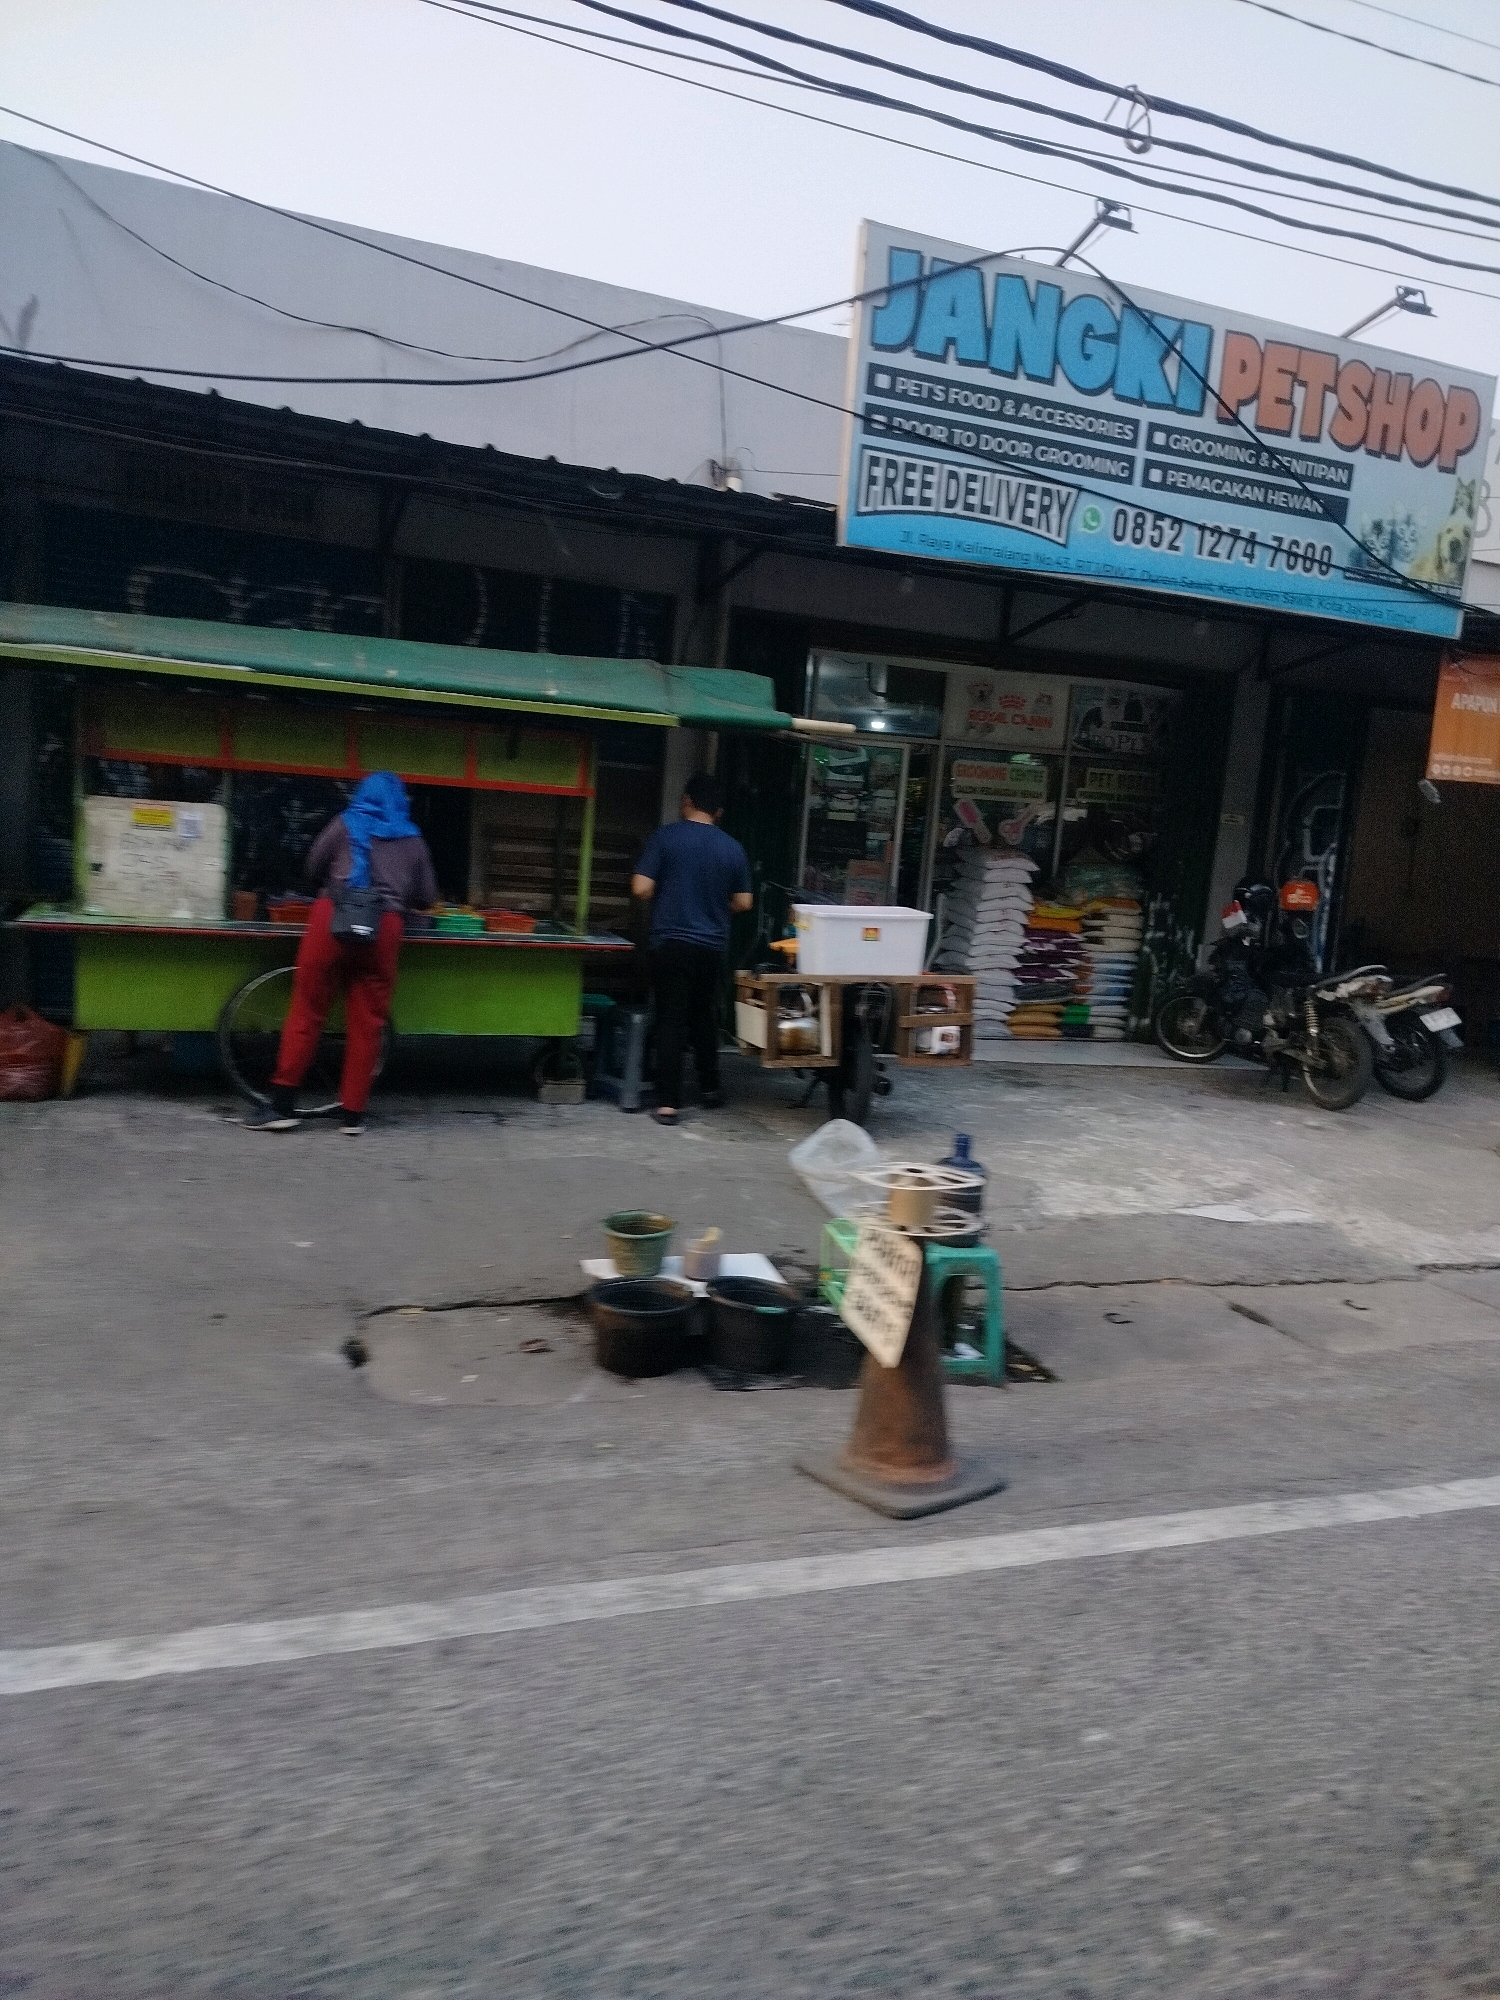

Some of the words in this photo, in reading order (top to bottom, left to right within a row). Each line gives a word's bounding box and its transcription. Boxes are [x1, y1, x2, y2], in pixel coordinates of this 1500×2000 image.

[871, 245, 1214, 418] JANGKI
[1216, 329, 1481, 475] PETSHOP
[948, 389, 1000, 412] FOOD
[1002, 400, 1016, 417] &
[1018, 403, 1134, 441] ACCESSORIES
[891, 416, 949, 441] DOOR
[951, 429, 978, 447] TO
[979, 434, 1034, 460] DOOR
[1034, 445, 1131, 478] GROOMING
[1169, 434, 1257, 465] GROOMING
[1259, 452, 1270, 468] &
[863, 453, 937, 509] FREE
[942, 465, 1077, 541] DELIVERY
[1165, 469, 1265, 503] PEMACAKAN
[1266, 488, 1325, 515] HEWAN
[1112, 508, 1183, 552] 0852
[1198, 523, 1257, 564] 1274
